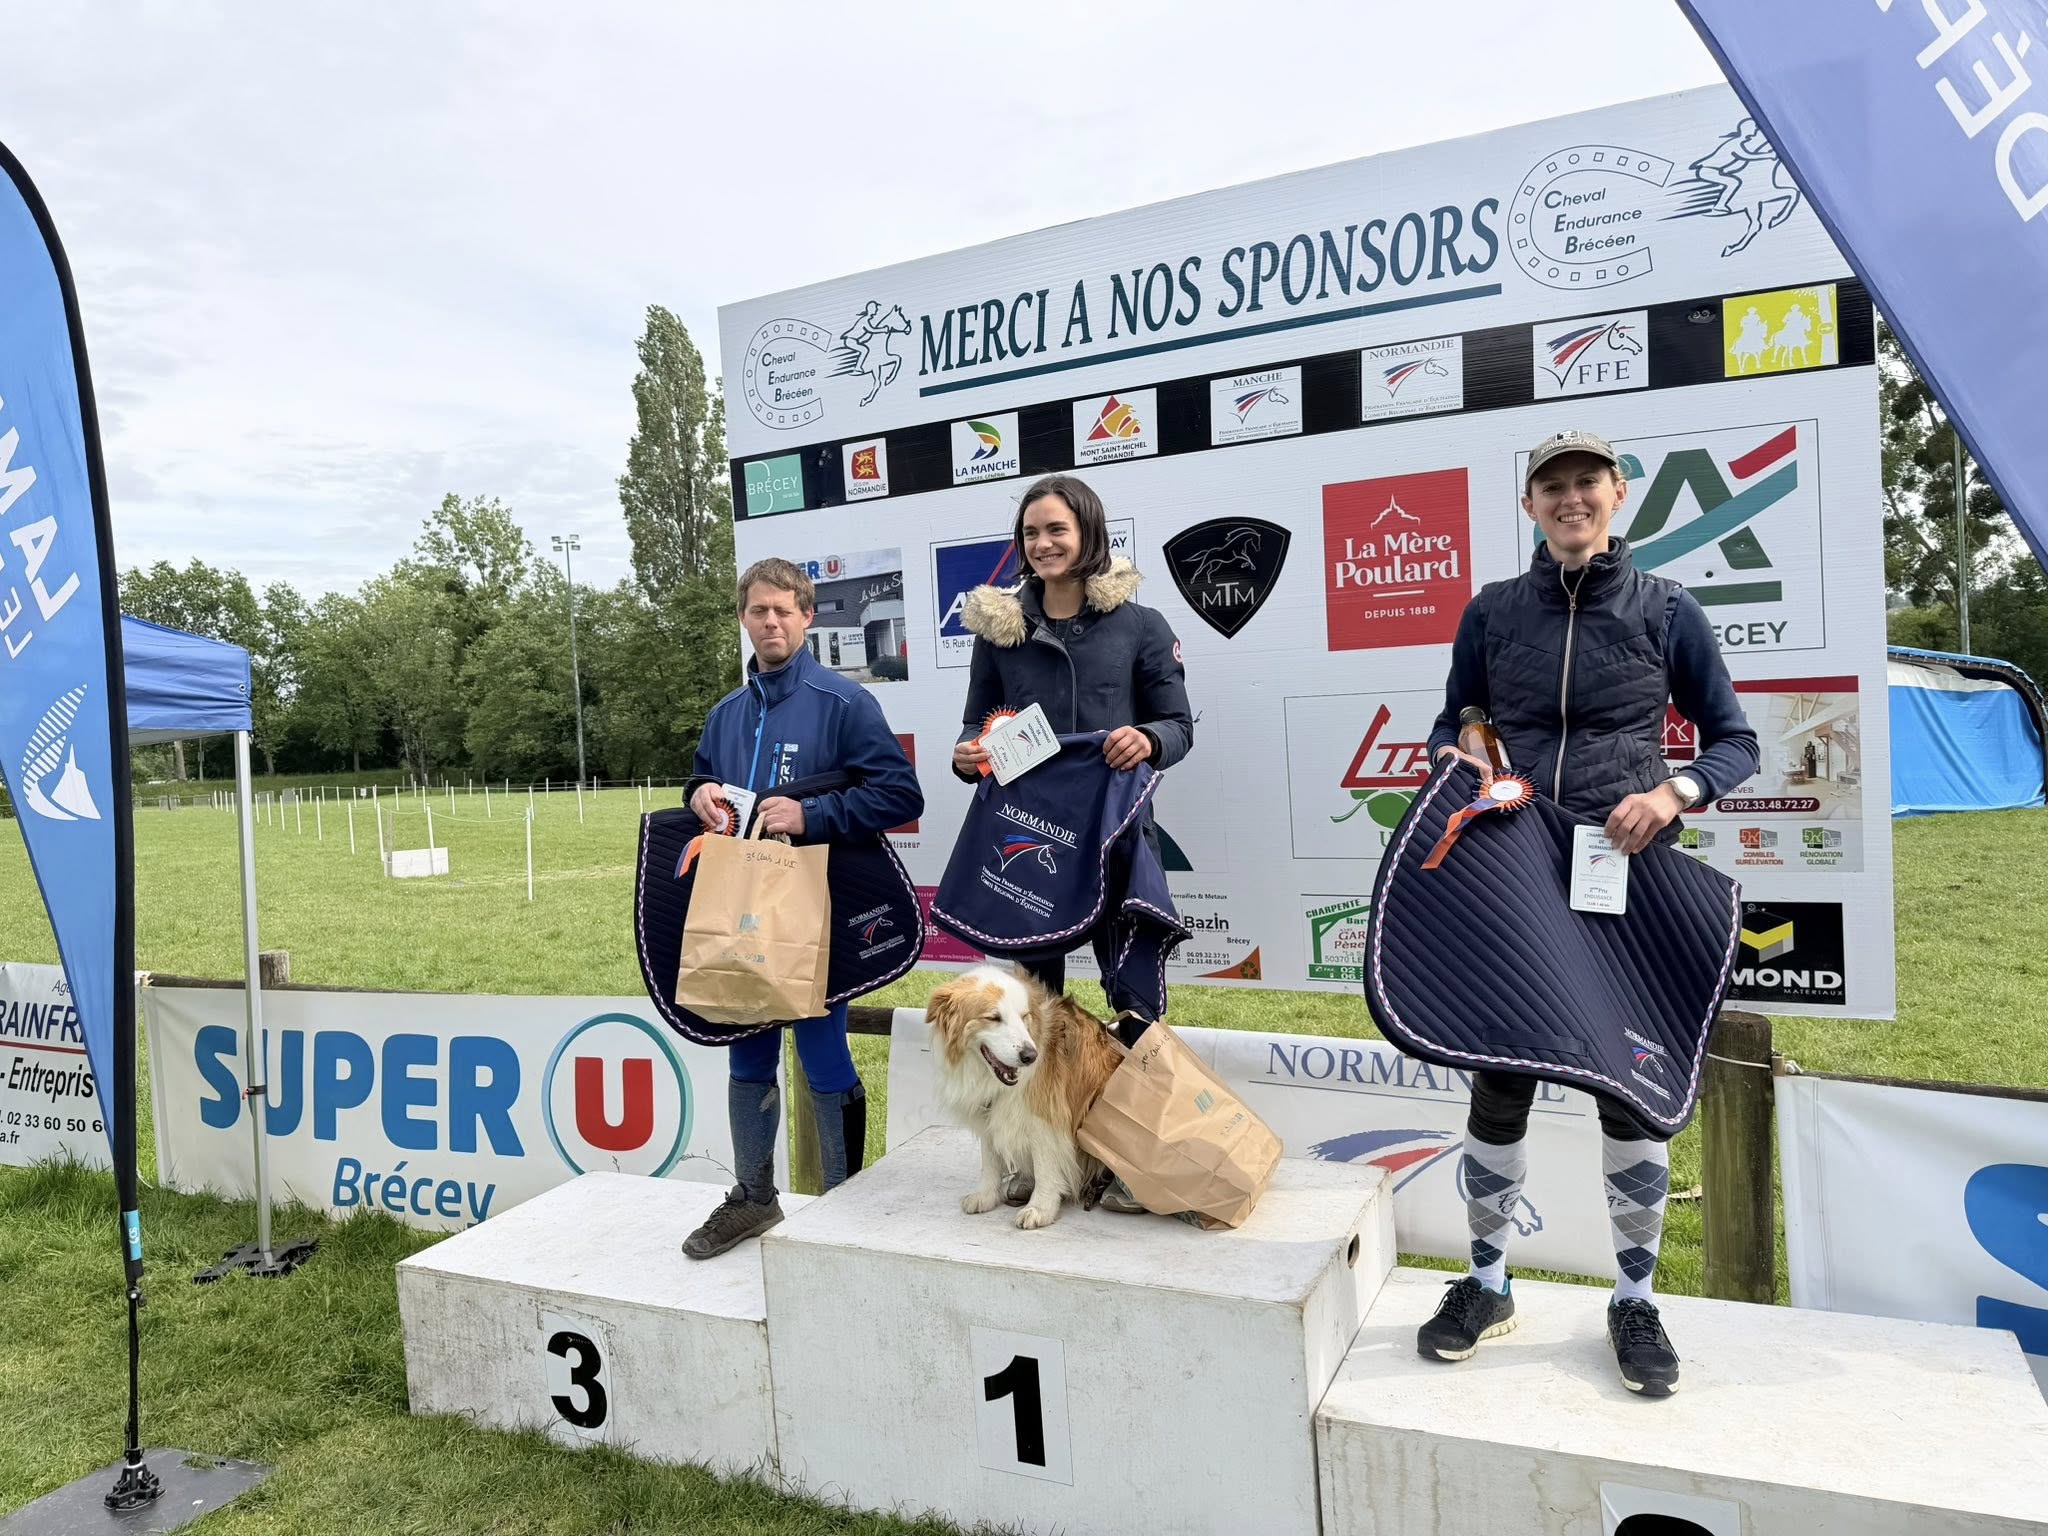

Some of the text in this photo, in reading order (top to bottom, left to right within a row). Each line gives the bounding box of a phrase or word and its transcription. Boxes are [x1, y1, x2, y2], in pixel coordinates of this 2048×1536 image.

[1544, 188, 1607, 209] Cheval
[1554, 207, 1642, 233] Endurance
[1564, 233, 1636, 255] Brécéen
[918, 197, 1500, 376] MERCI A NOS SPONSORS
[761, 351, 796, 368] Cheval
[1369, 338, 1454, 360] NORMANDIE
[768, 367, 816, 386] Endurance
[1232, 371, 1283, 388] MANCHE
[1578, 359, 1631, 385] FFE
[774, 386, 813, 402] Brécéen
[1080, 441, 1148, 457] MONT SAINT-MICHEL
[1093, 451, 1135, 462] NORMANDIE
[955, 459, 1017, 477] LA MANCHE
[847, 483, 887, 497] NORMANDIE
[1345, 530, 1451, 561] La Mère
[1335, 550, 1460, 588] Poulard
[1201, 582, 1256, 609] MTM
[1364, 605, 1436, 620] DEPUIS 1888
[952, 638, 965, 648] Rue
[1736, 799, 1814, 811] 02.33.48.72.27
[1001, 803, 1078, 844] NORMANDIE
[1305, 899, 1361, 918] CHARPENTE
[1184, 912, 1229, 930] Bazin
[194, 1025, 654, 1157] SUPER U
[7, 1112, 21, 1125] 02
[24, 1114, 39, 1128] 33
[44, 1117, 61, 1131] 60
[67, 1118, 86, 1132] 50
[92, 1119, 106, 1133] 6
[332, 1157, 496, 1228] Brécey
[546, 1331, 608, 1430] 3
[983, 1354, 1047, 1467] 1
